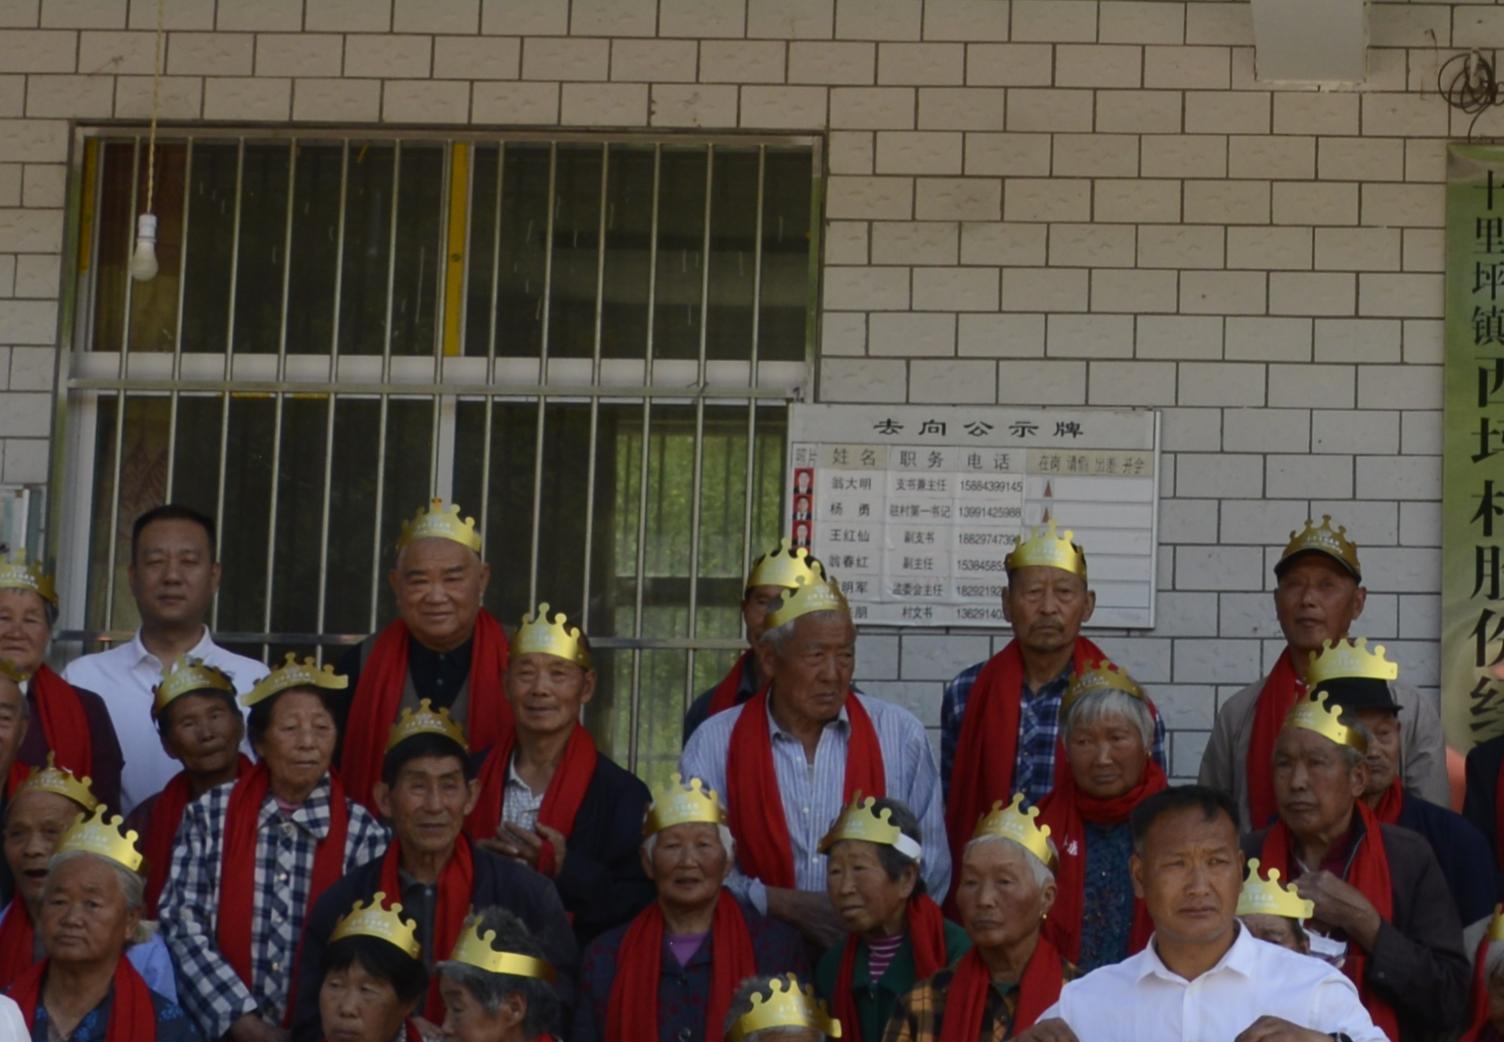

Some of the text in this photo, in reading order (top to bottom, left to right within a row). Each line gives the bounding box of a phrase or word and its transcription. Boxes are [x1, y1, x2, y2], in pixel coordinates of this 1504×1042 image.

[873, 418, 1084, 439] 去向公示牌
[832, 448, 876, 466] 姓名
[899, 450, 944, 468] 职务
[967, 453, 1010, 471] 电话
[904, 531, 934, 543] 副支书
[903, 557, 933, 570] 副主任
